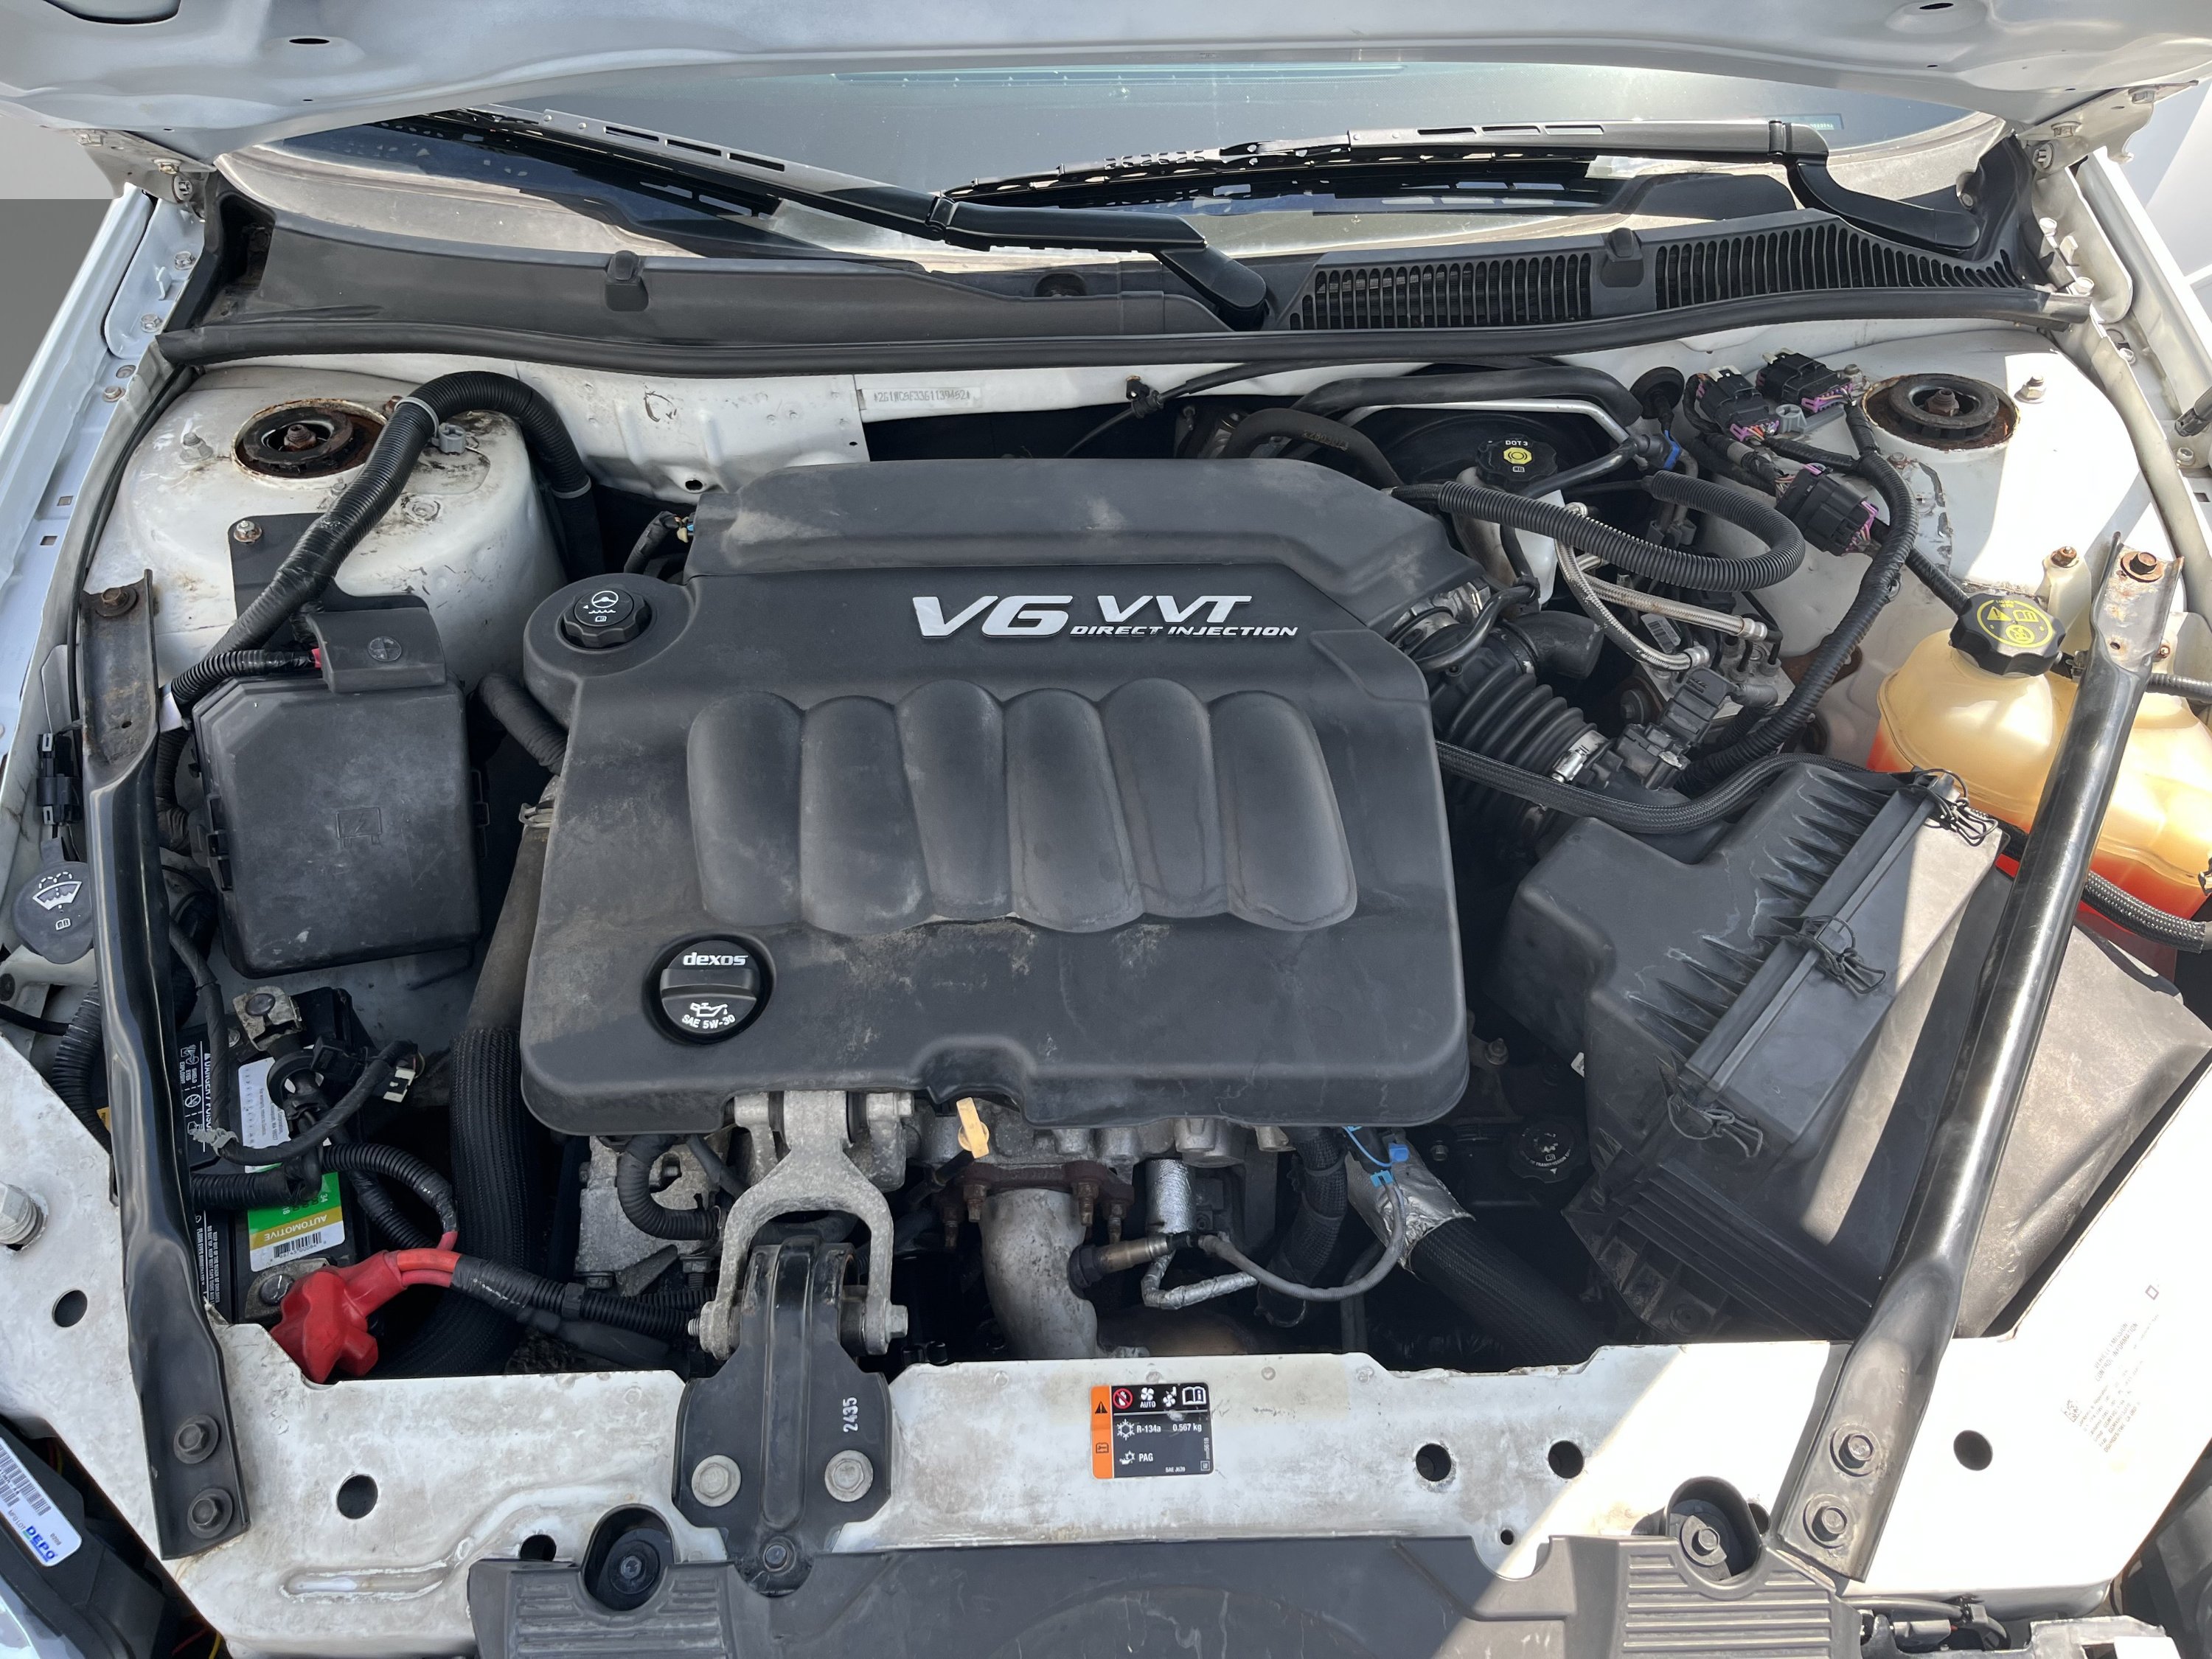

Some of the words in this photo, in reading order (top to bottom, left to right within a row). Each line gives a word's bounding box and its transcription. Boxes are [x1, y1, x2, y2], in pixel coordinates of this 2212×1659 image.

[913, 595, 1073, 637] V6
[1097, 595, 1252, 623] VVT
[1069, 625, 1164, 637] DIRECT
[1168, 625, 1298, 637] INJECTION
[683, 952, 748, 965] dexos
[682, 1014, 700, 1028] SAE
[703, 1015, 735, 1029] 5W-30
[264, 1214, 327, 1241] AUTOMOTIVE
[843, 1397, 858, 1432] 2435
[1136, 1425, 1161, 1433] R-134a
[1193, 1423, 1202, 1432] kg
[1139, 1453, 1153, 1461] PAG
[26, 1526, 55, 1559] DEPO
